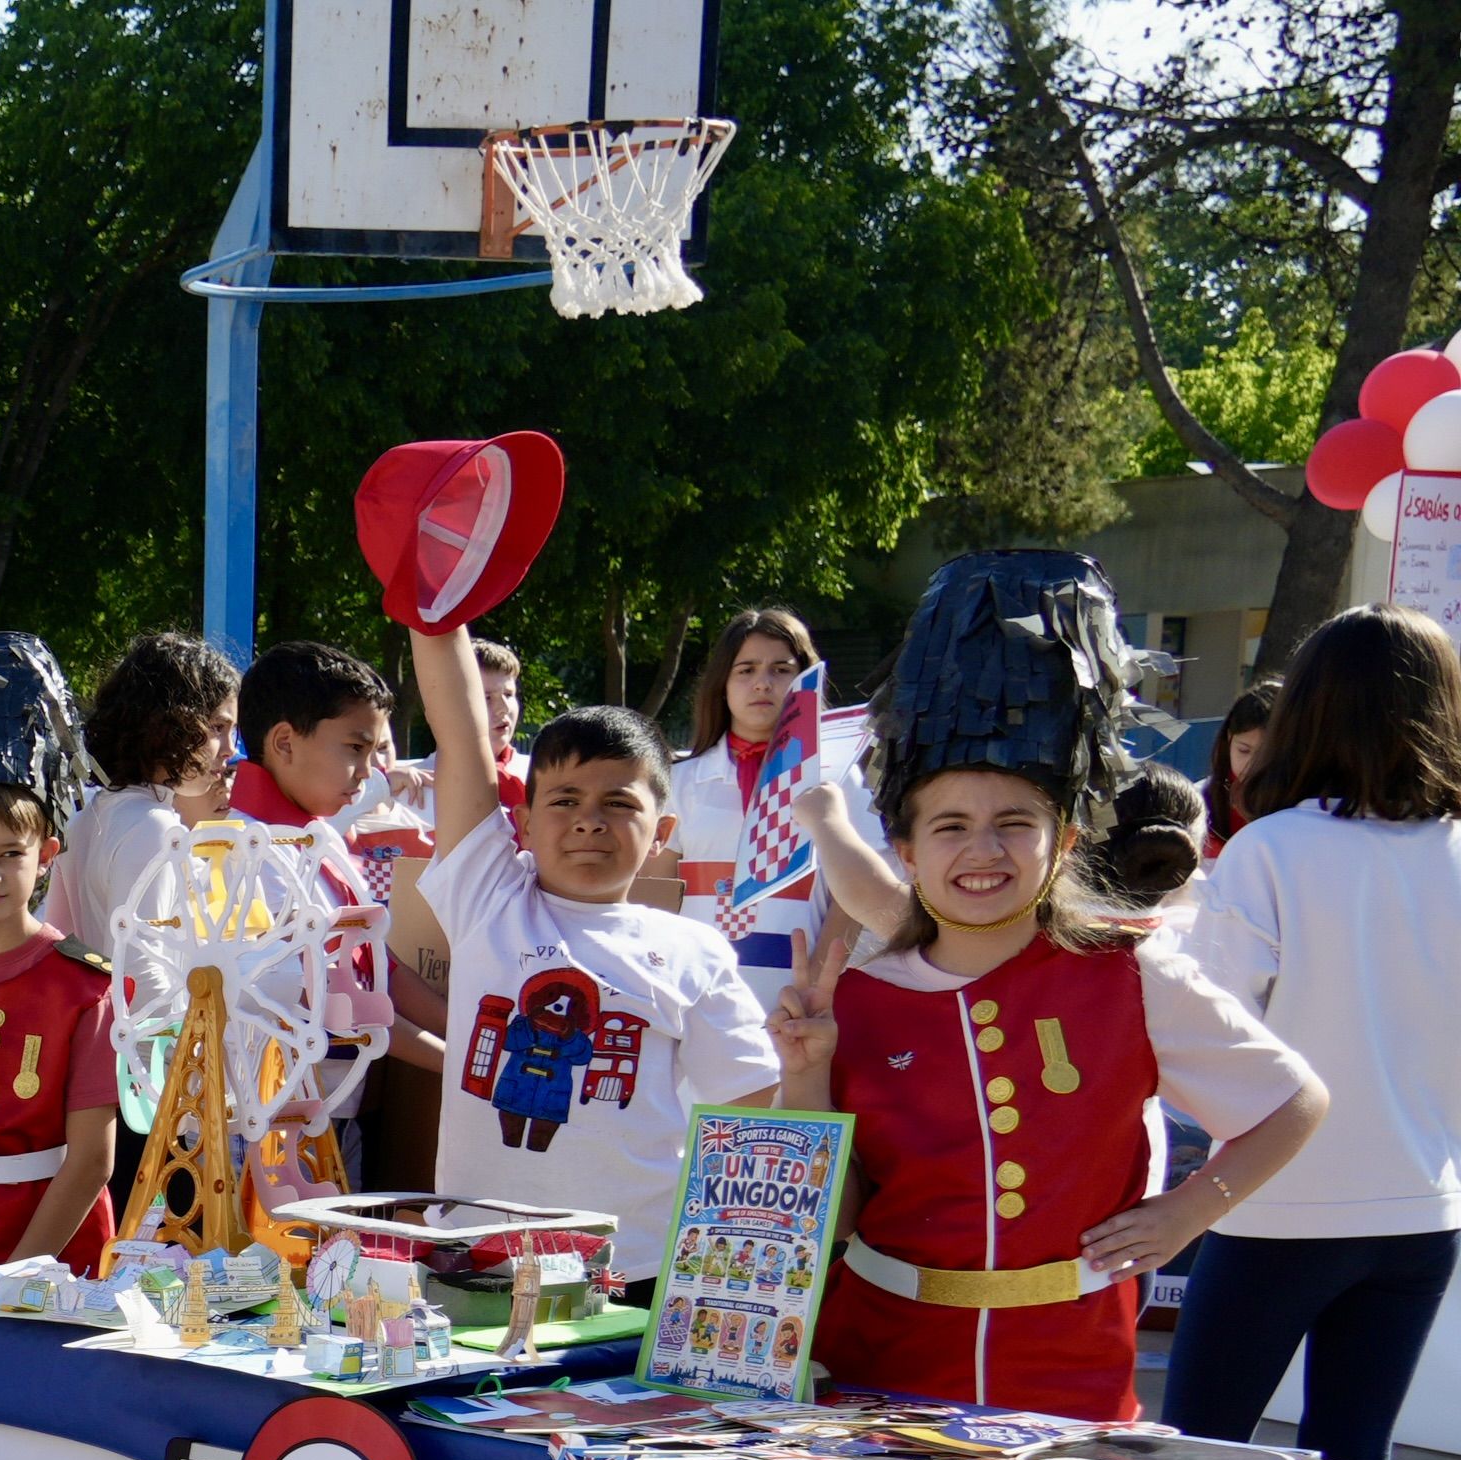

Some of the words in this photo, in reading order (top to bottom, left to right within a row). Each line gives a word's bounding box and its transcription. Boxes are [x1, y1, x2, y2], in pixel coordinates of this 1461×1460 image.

[737, 1129, 768, 1142] SPORTS
[769, 1129, 775, 1138] &
[776, 1130, 805, 1146] GAMES
[703, 1177, 820, 1216] KINGDOM
